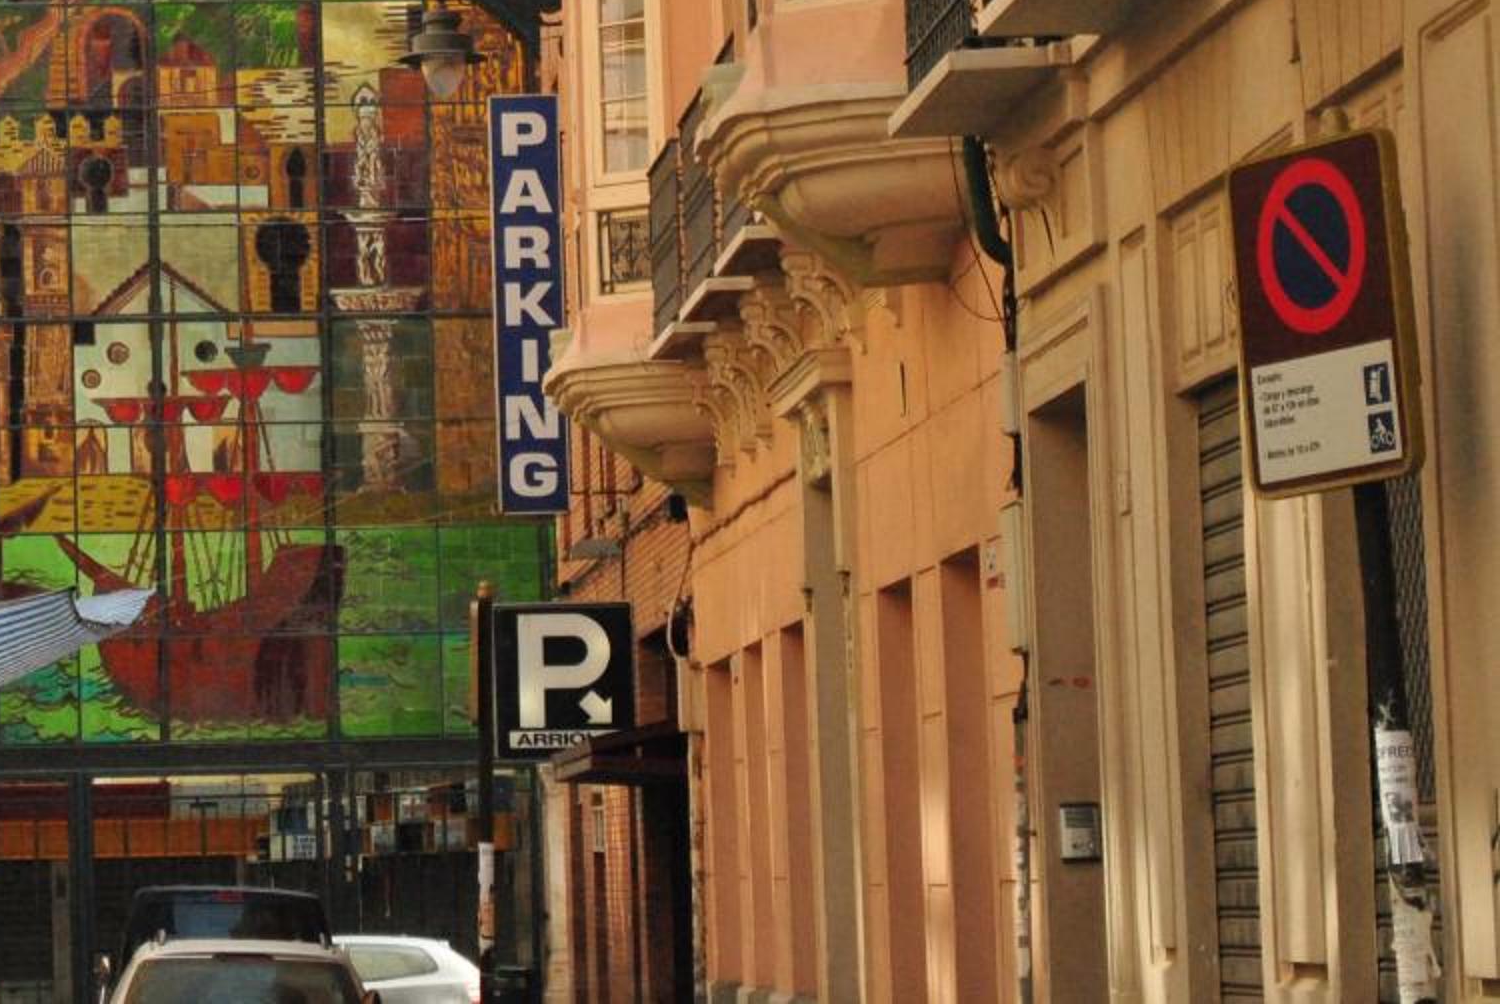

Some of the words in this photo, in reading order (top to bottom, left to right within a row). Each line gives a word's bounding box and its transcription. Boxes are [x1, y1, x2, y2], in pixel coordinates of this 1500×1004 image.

[499, 111, 560, 498] PARKING
[517, 613, 611, 729] P
[517, 732, 591, 747] ARRIO
